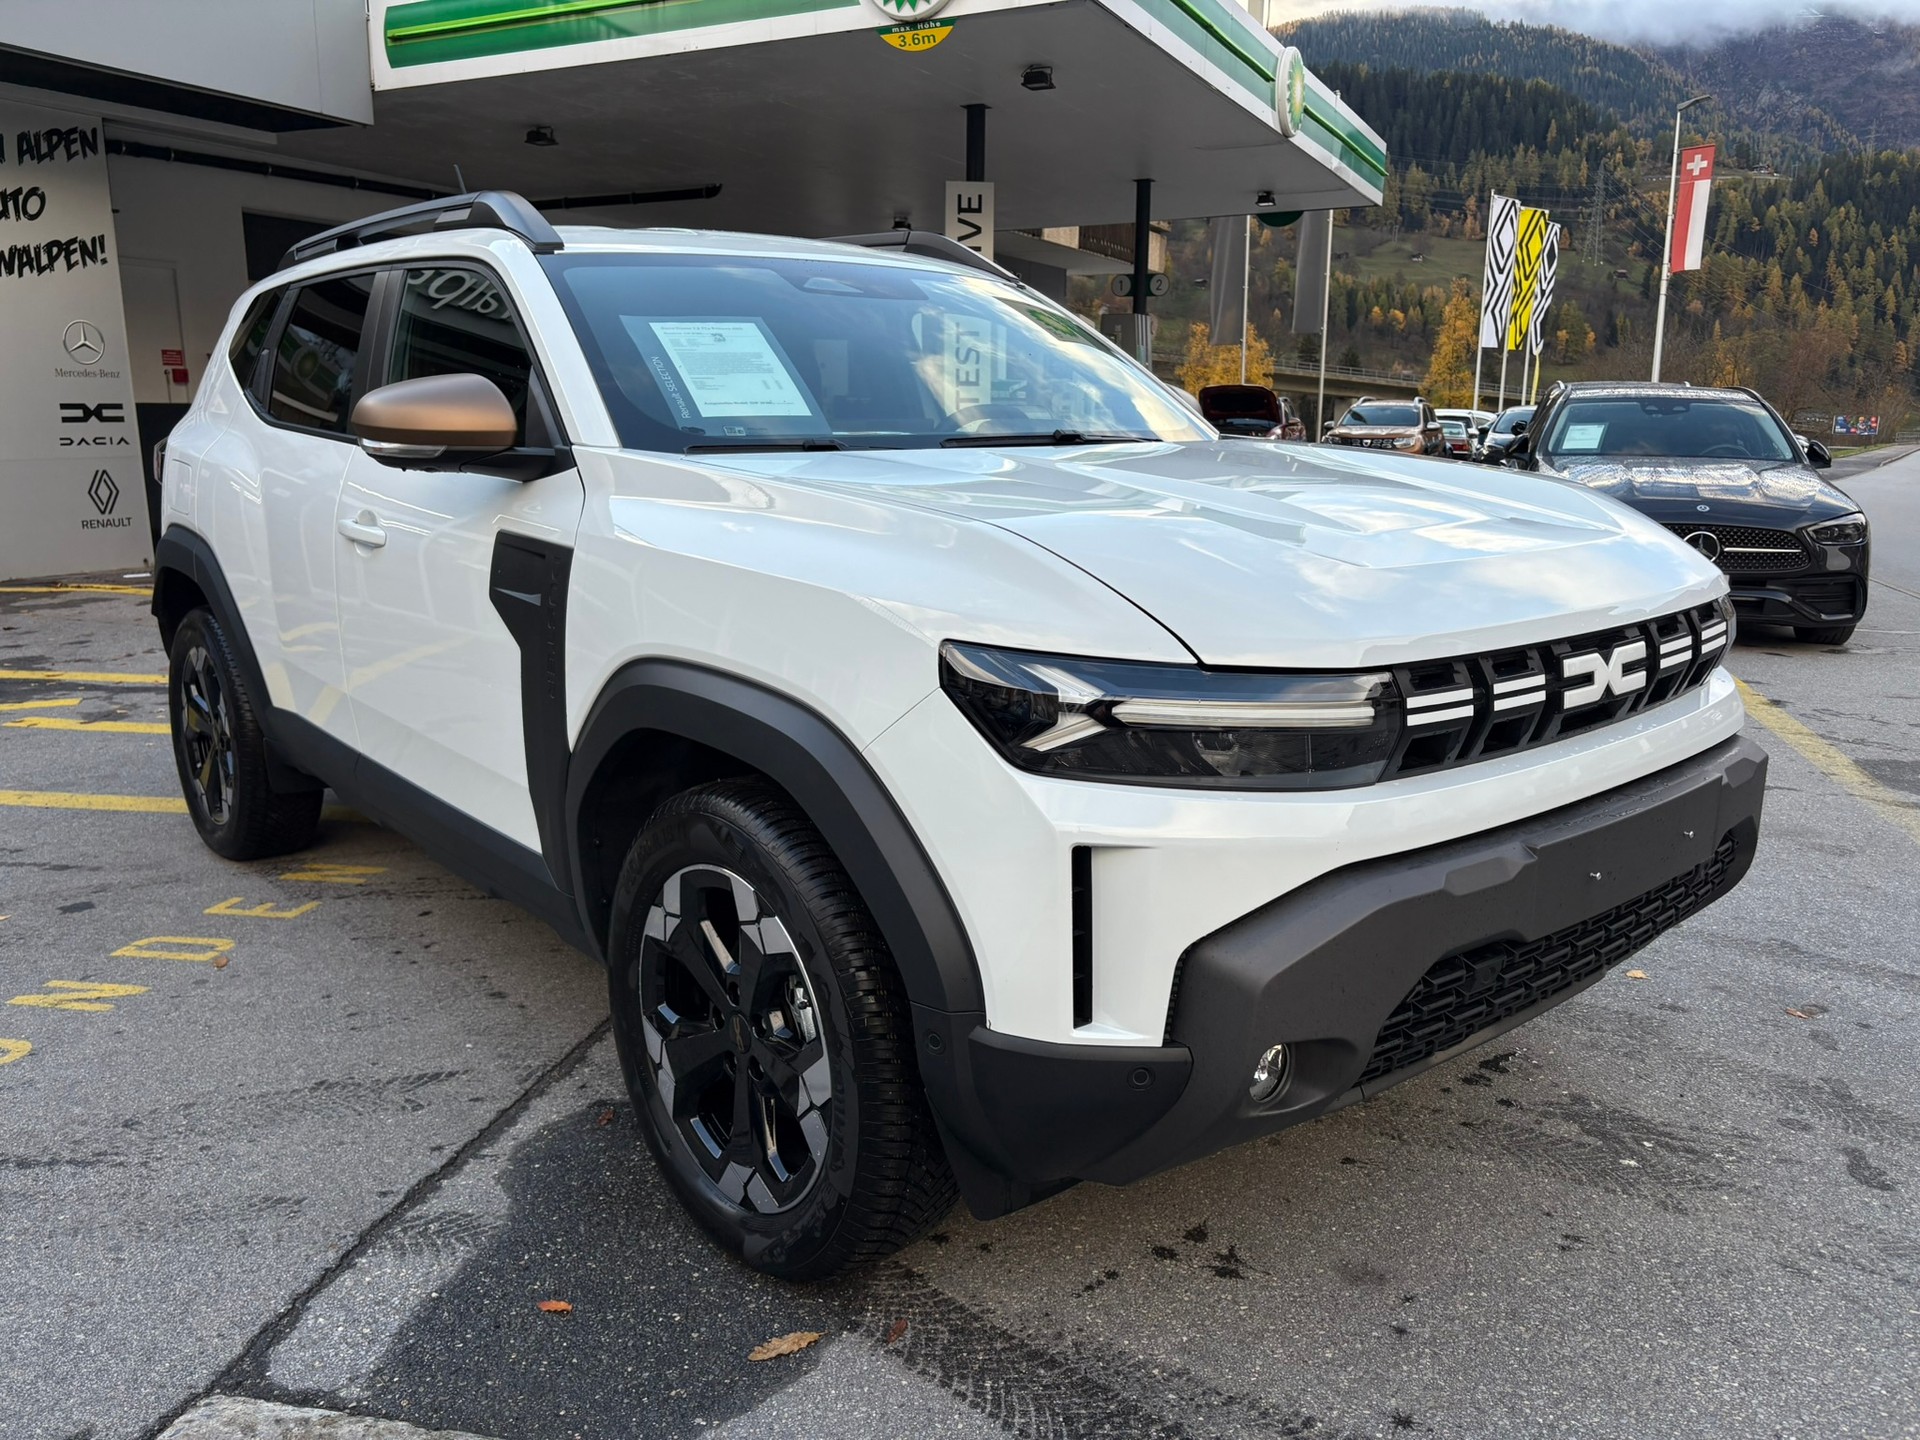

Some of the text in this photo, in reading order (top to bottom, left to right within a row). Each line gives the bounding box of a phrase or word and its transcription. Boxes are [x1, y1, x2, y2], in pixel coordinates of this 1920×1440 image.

[917, 21, 942, 31] Höhe
[898, 33, 936, 48] 3.6m
[17, 126, 98, 166] ALPEN
[1155, 279, 1162, 291] 2
[955, 322, 981, 411] TEST
[54, 368, 121, 379] Mercedes-Benz
[59, 437, 130, 446] DACIA
[81, 516, 133, 530] RENAULT
